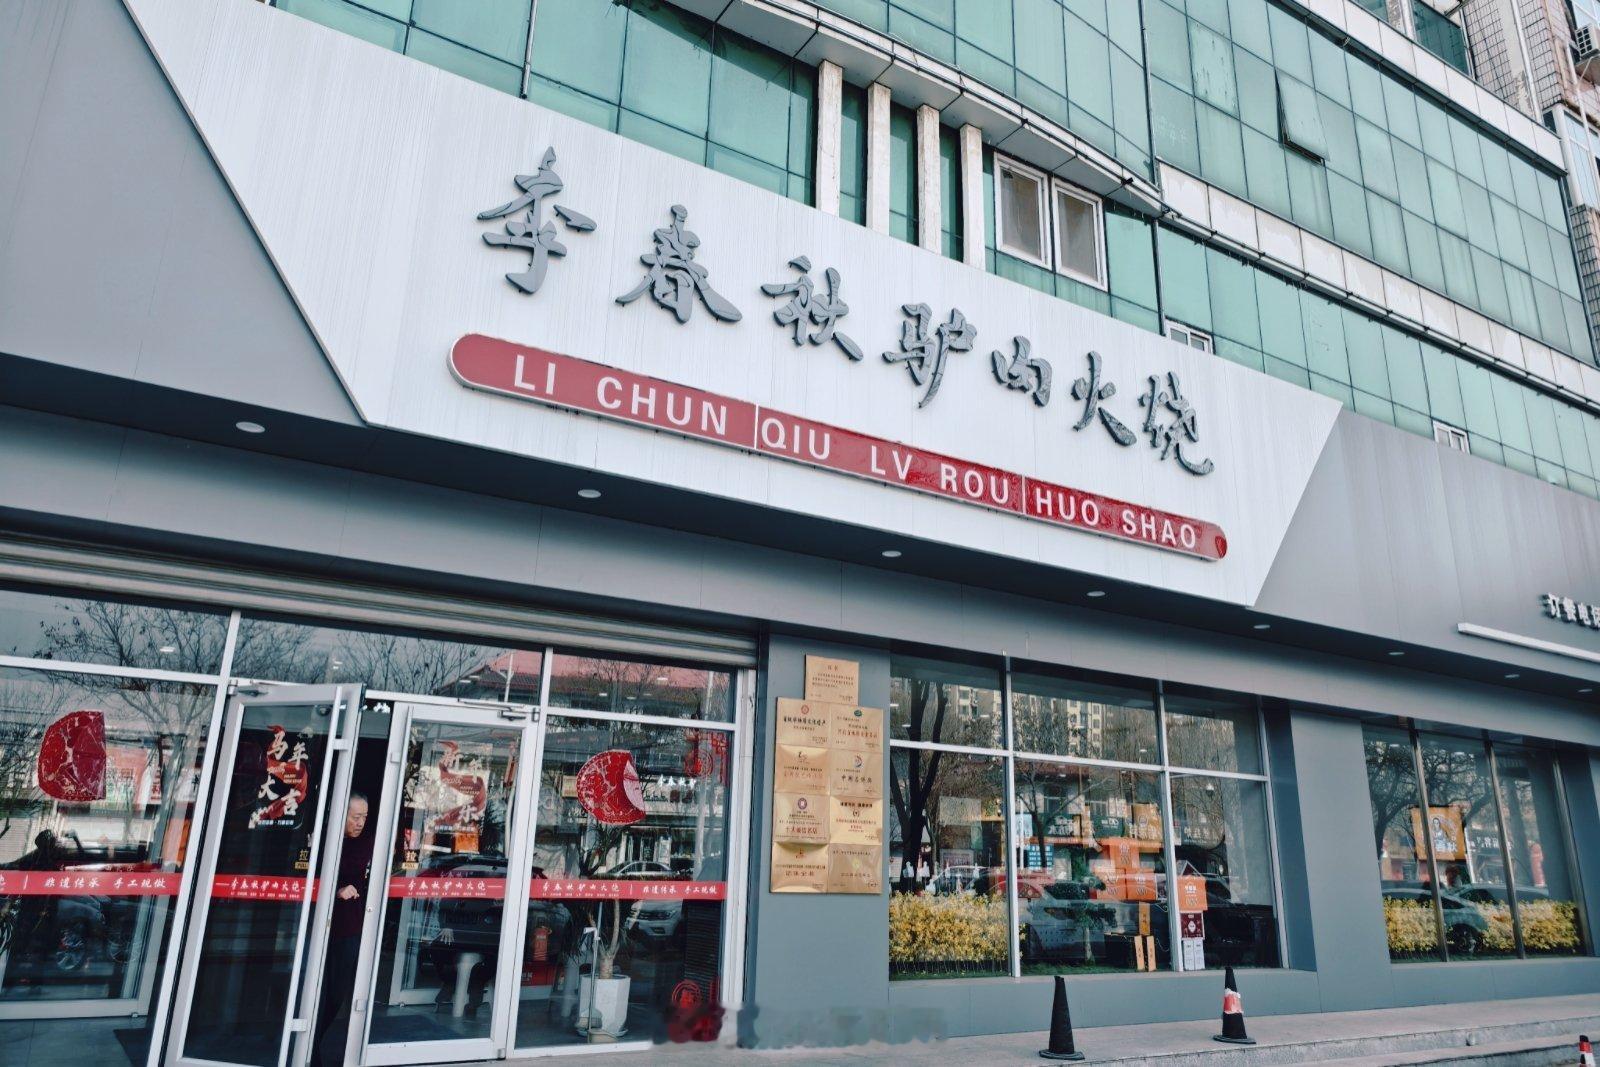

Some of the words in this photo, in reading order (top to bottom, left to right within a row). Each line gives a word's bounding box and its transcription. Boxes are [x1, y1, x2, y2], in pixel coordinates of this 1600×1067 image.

[477, 146, 1215, 476] 李春秋驴肉火烧
[514, 354, 556, 395] LI
[597, 376, 727, 435] CHUN
[761, 418, 830, 460] QIU
[871, 445, 912, 480] LV
[941, 462, 1009, 504] ROU
[1035, 488, 1099, 527] HUO
[1122, 508, 1196, 549] SHAO
